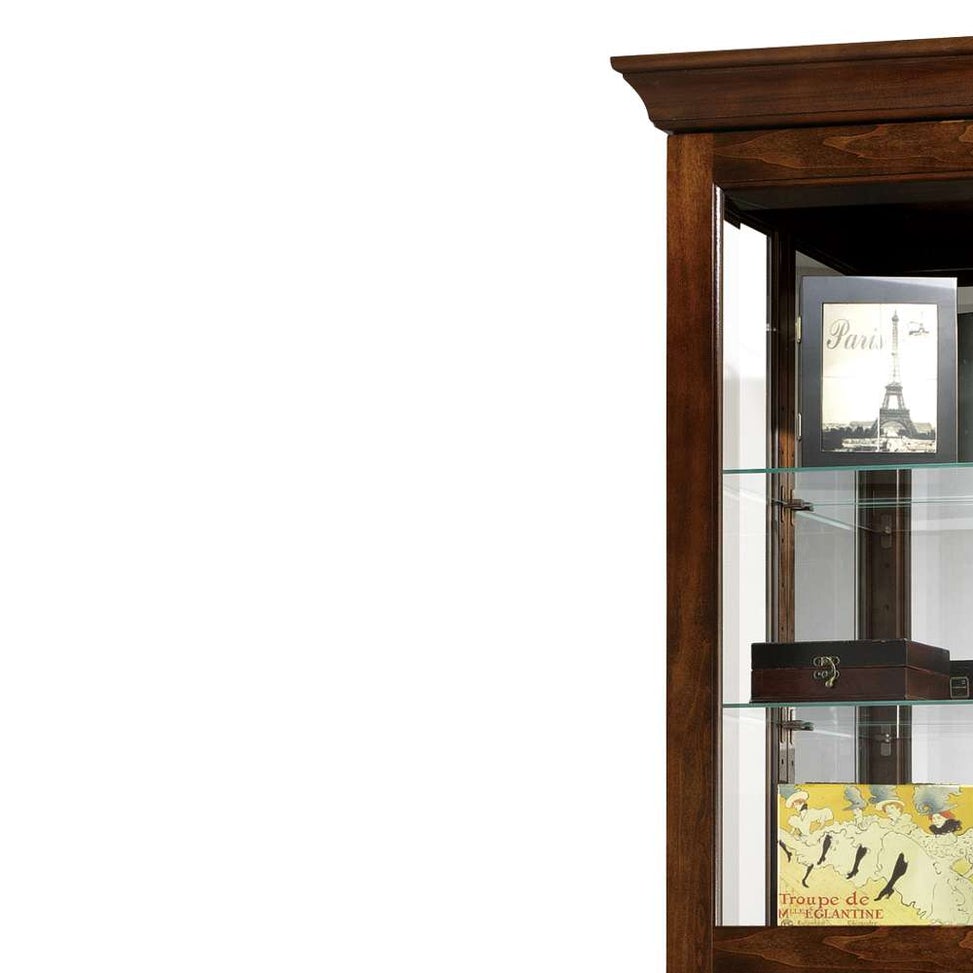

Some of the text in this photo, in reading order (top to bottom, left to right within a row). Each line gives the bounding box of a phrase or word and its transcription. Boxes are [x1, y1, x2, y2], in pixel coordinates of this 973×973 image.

[826, 318, 886, 350] Paris
[779, 891, 870, 908] Troupe de
